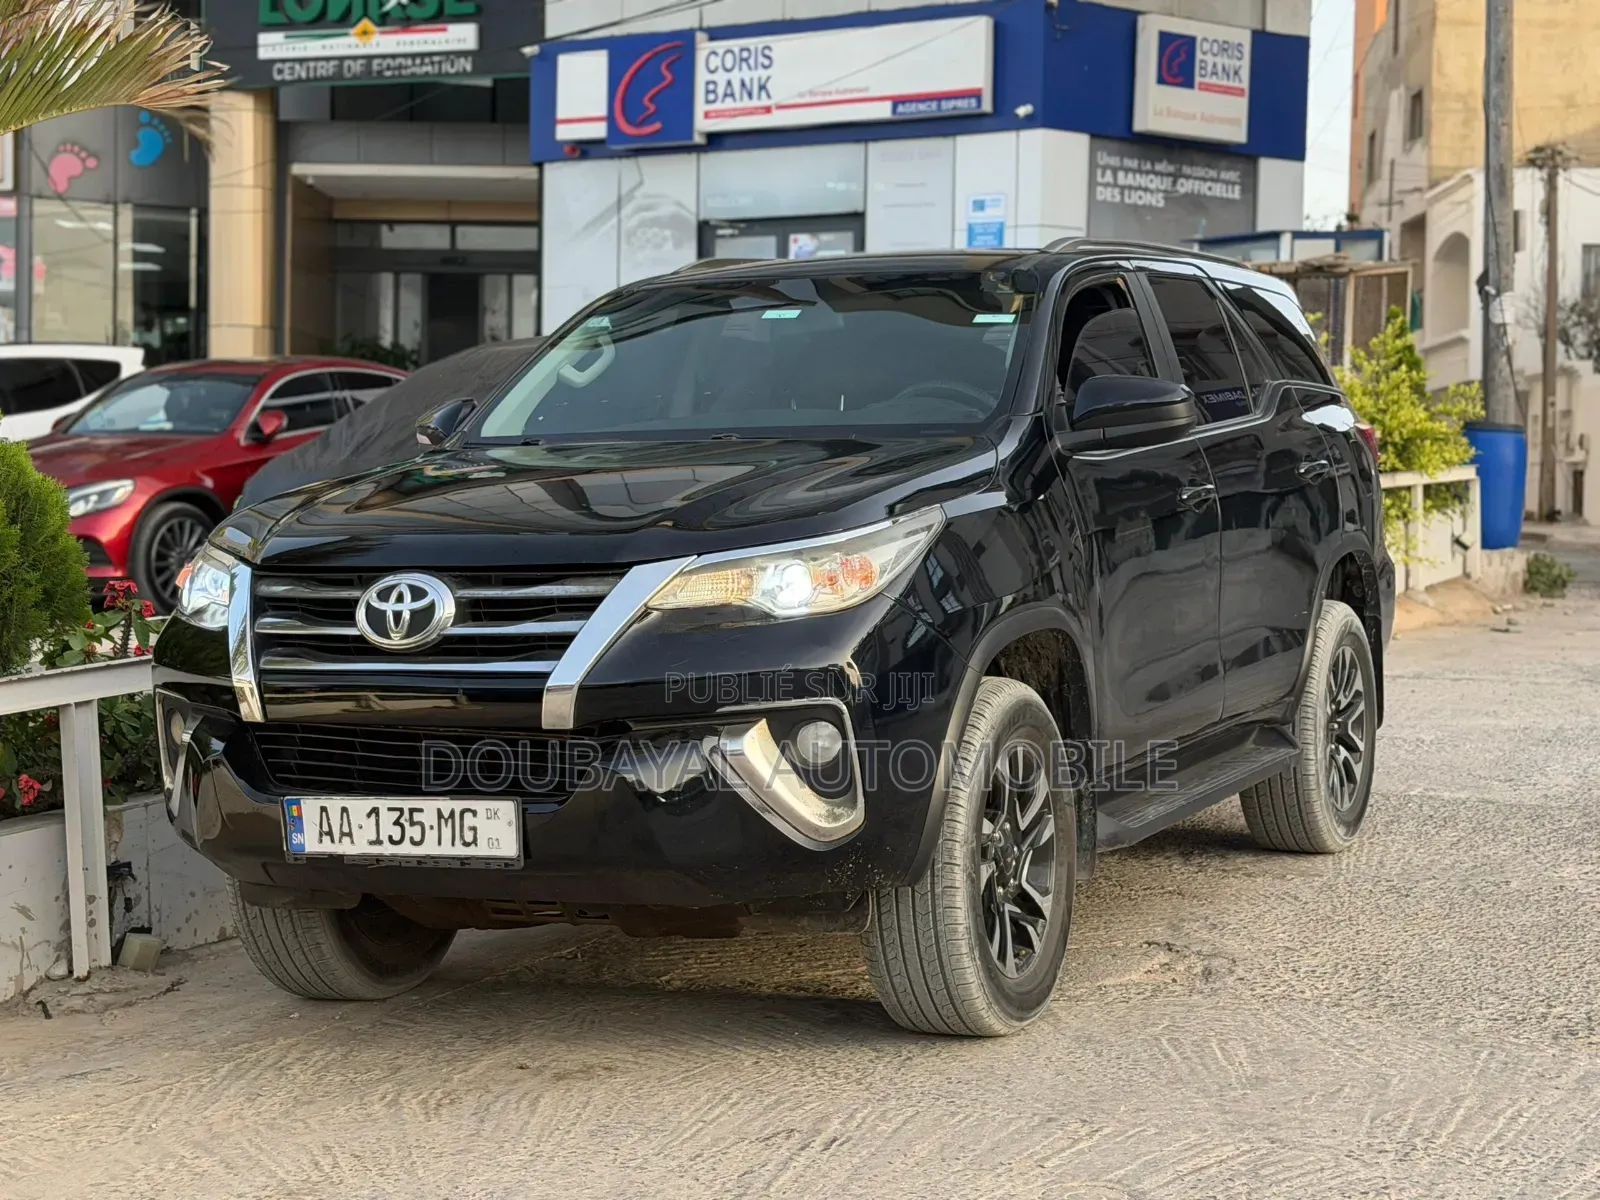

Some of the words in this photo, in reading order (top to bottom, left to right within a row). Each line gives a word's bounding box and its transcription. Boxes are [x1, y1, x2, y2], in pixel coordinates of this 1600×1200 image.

[705, 45, 774, 74] CORIS
[1199, 37, 1245, 61] CORIS
[1198, 59, 1244, 83] BANK
[704, 75, 773, 104] BANK
[1096, 168, 1114, 184] LA
[1117, 170, 1173, 190] BANQUE
[1176, 177, 1241, 199] OFFICIELLE
[1096, 186, 1121, 202] DES
[1123, 188, 1165, 208] LIONS
[485, 808, 501, 820] DK
[291, 833, 304, 844] SN
[487, 837, 502, 849] 01
